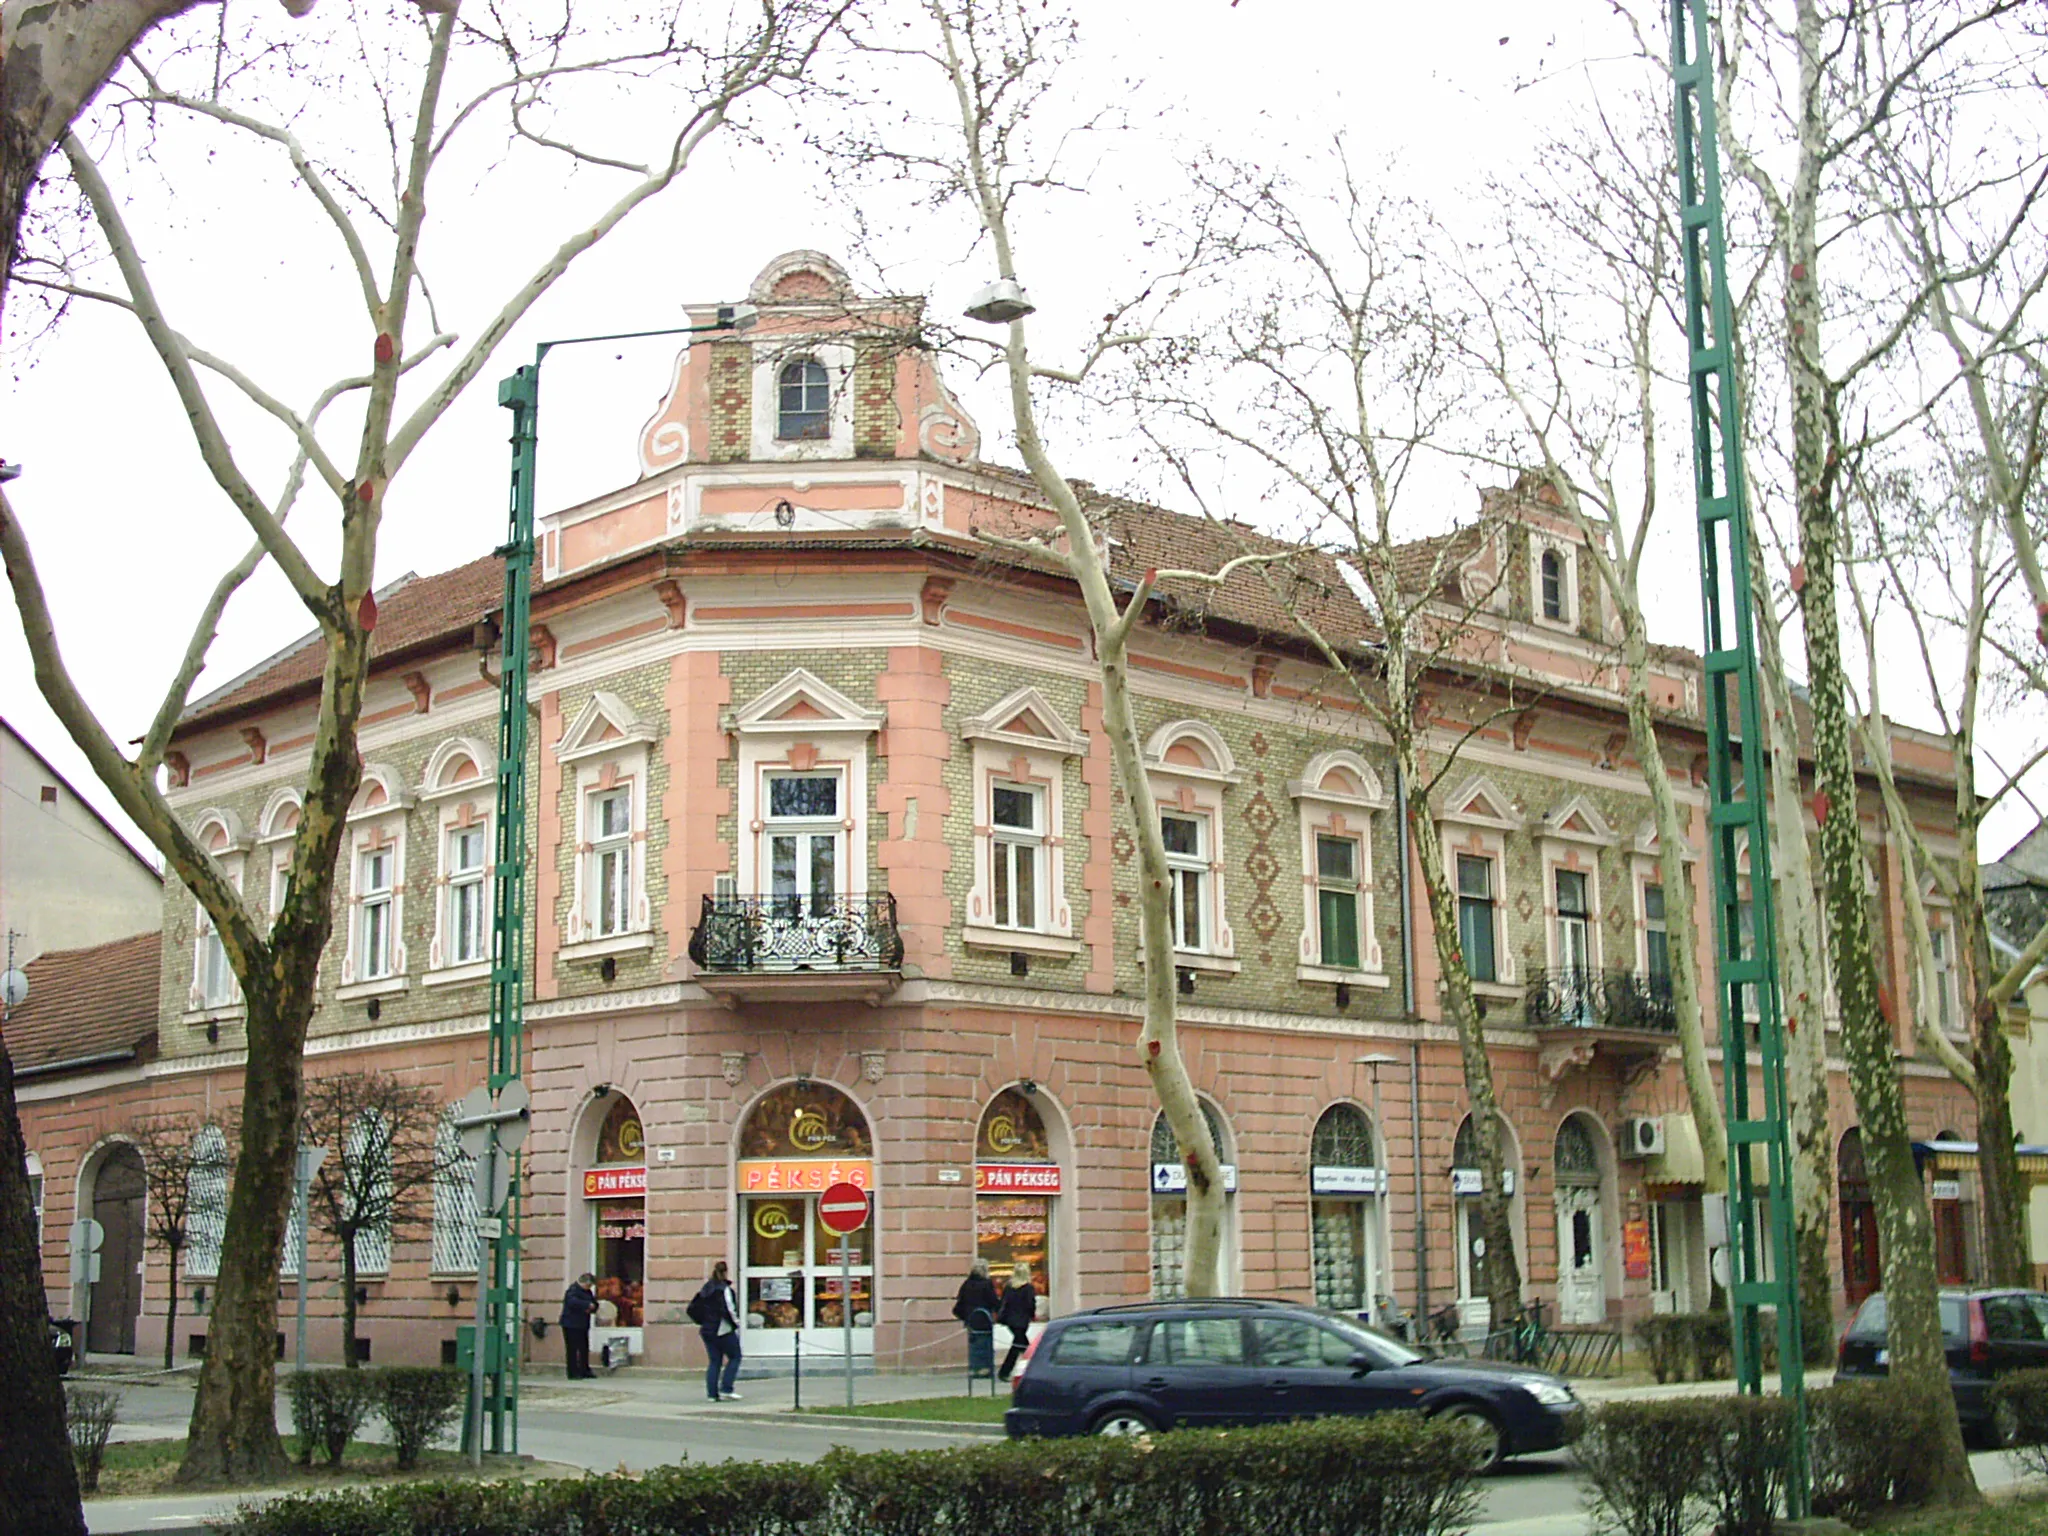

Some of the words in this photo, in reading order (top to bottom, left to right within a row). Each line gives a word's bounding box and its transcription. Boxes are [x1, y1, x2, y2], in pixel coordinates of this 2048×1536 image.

[598, 1173, 617, 1190] PÁN
[747, 1161, 865, 1189] PÉKSÉG
[987, 1169, 1012, 1186] PÁN
[1014, 1170, 1059, 1187] PÉKSÉG
